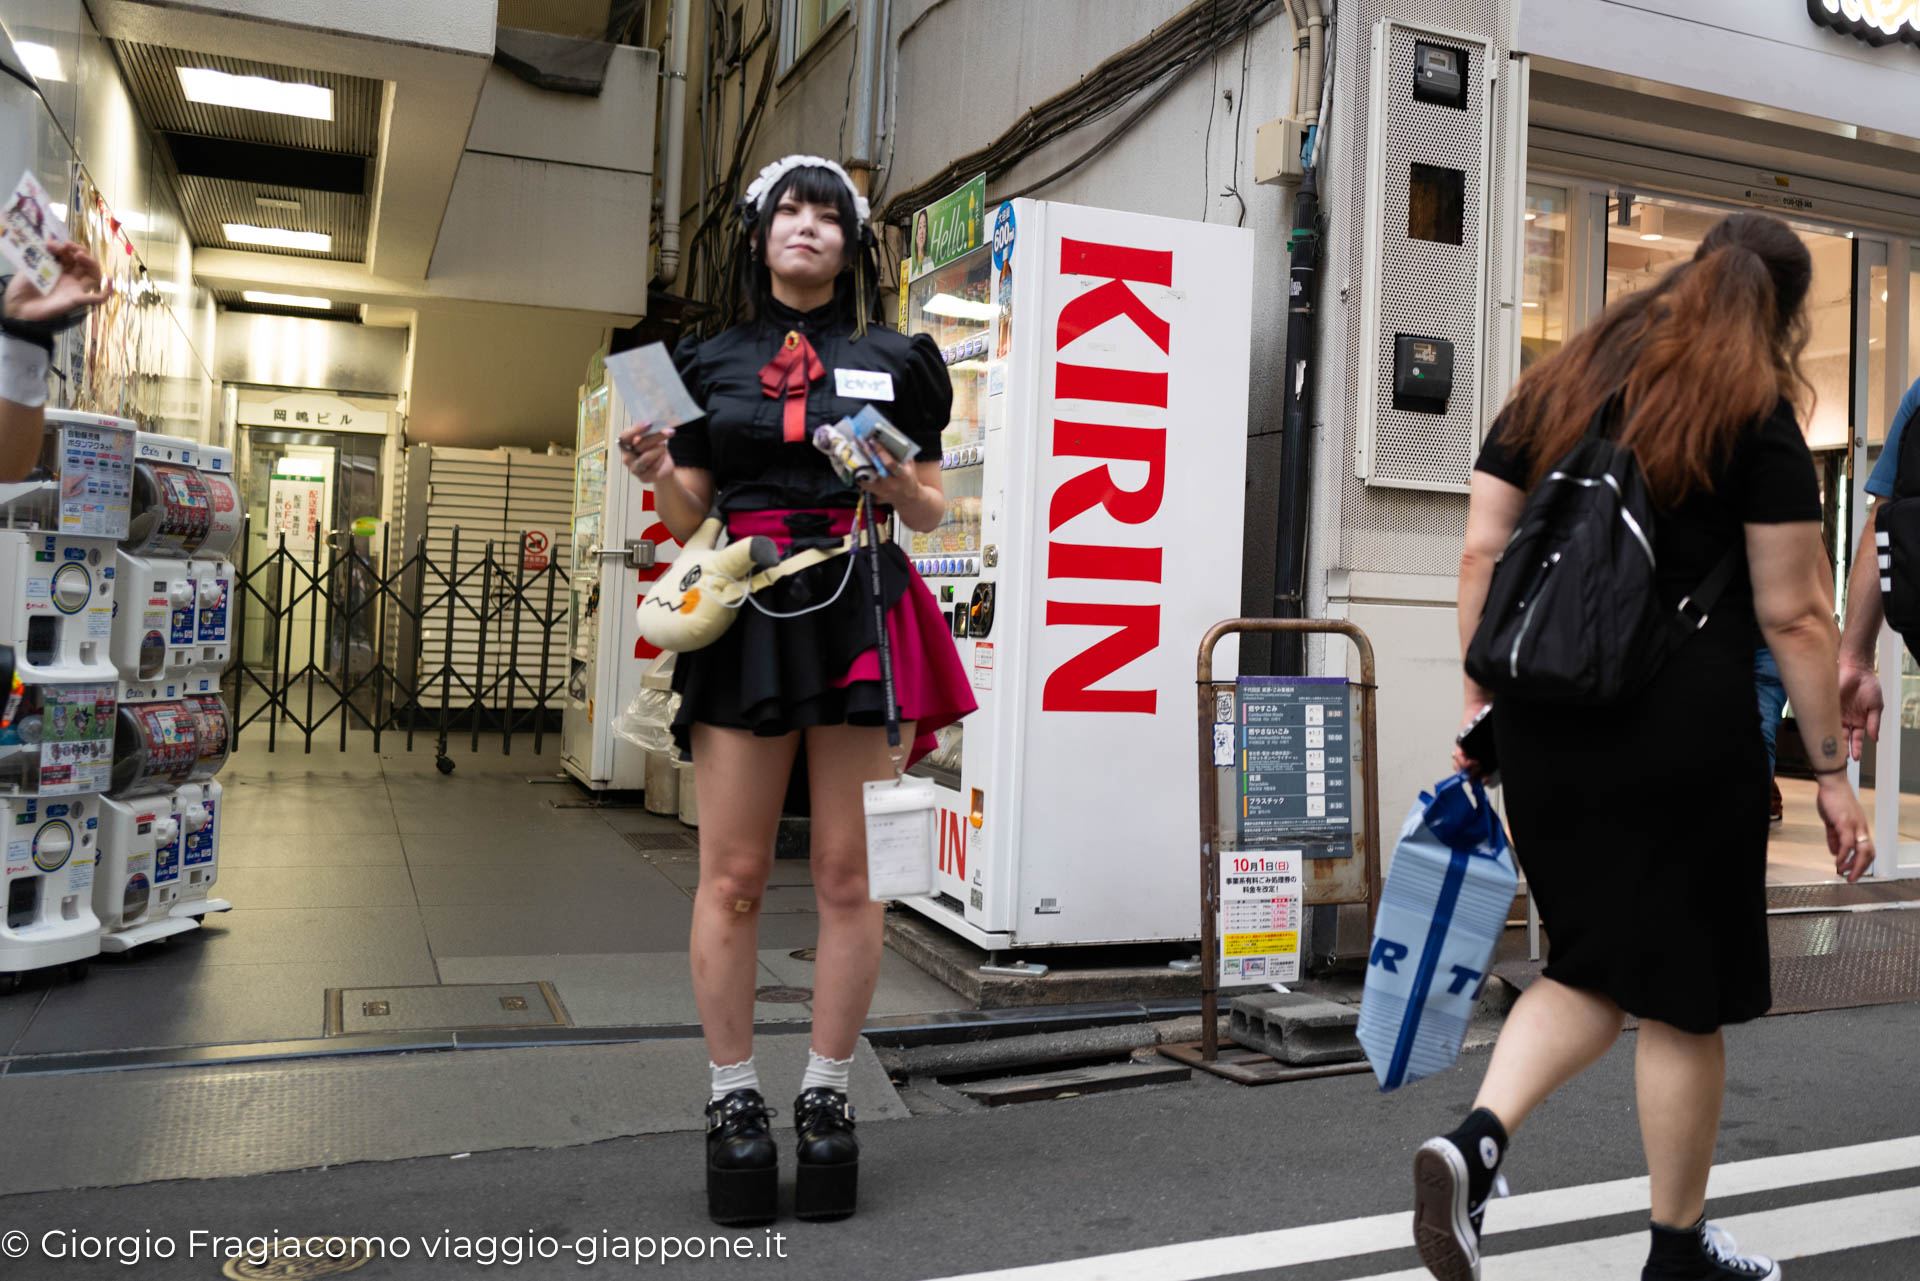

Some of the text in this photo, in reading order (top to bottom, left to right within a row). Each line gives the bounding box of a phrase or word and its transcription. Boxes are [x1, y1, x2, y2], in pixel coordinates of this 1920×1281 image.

[930, 205, 967, 263] Hello.
[273, 409, 352, 425] 岡嶋ビル
[1043, 237, 1173, 714] KIRIN
[1233, 858, 1289, 872] 10月1日(日)
